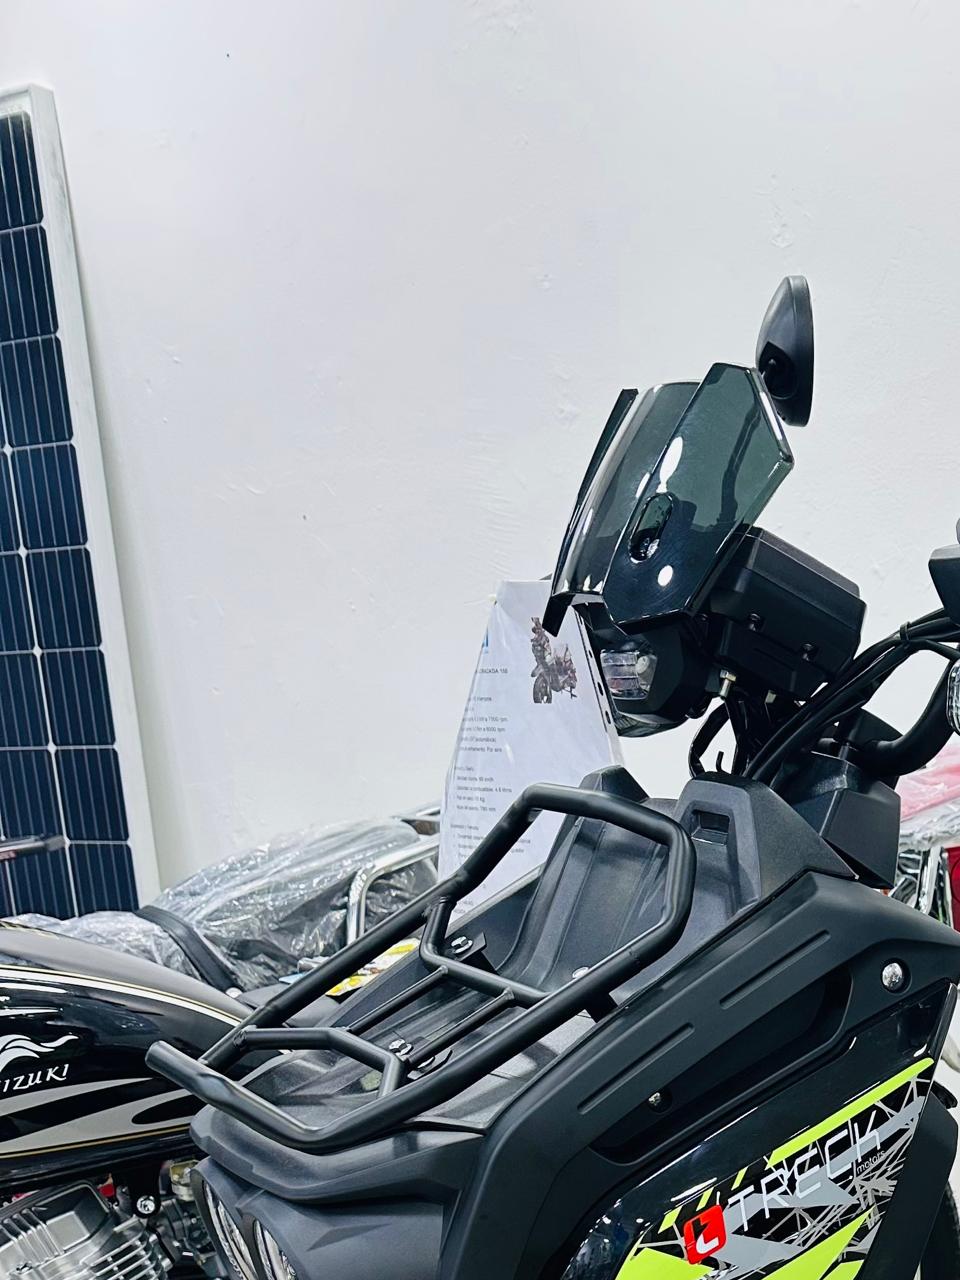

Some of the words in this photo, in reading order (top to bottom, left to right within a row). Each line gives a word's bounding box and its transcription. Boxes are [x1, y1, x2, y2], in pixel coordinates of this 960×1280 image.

[0, 1064, 69, 1093] IZUKI
[727, 1109, 881, 1232] TRECK
[856, 1150, 886, 1174] motors
